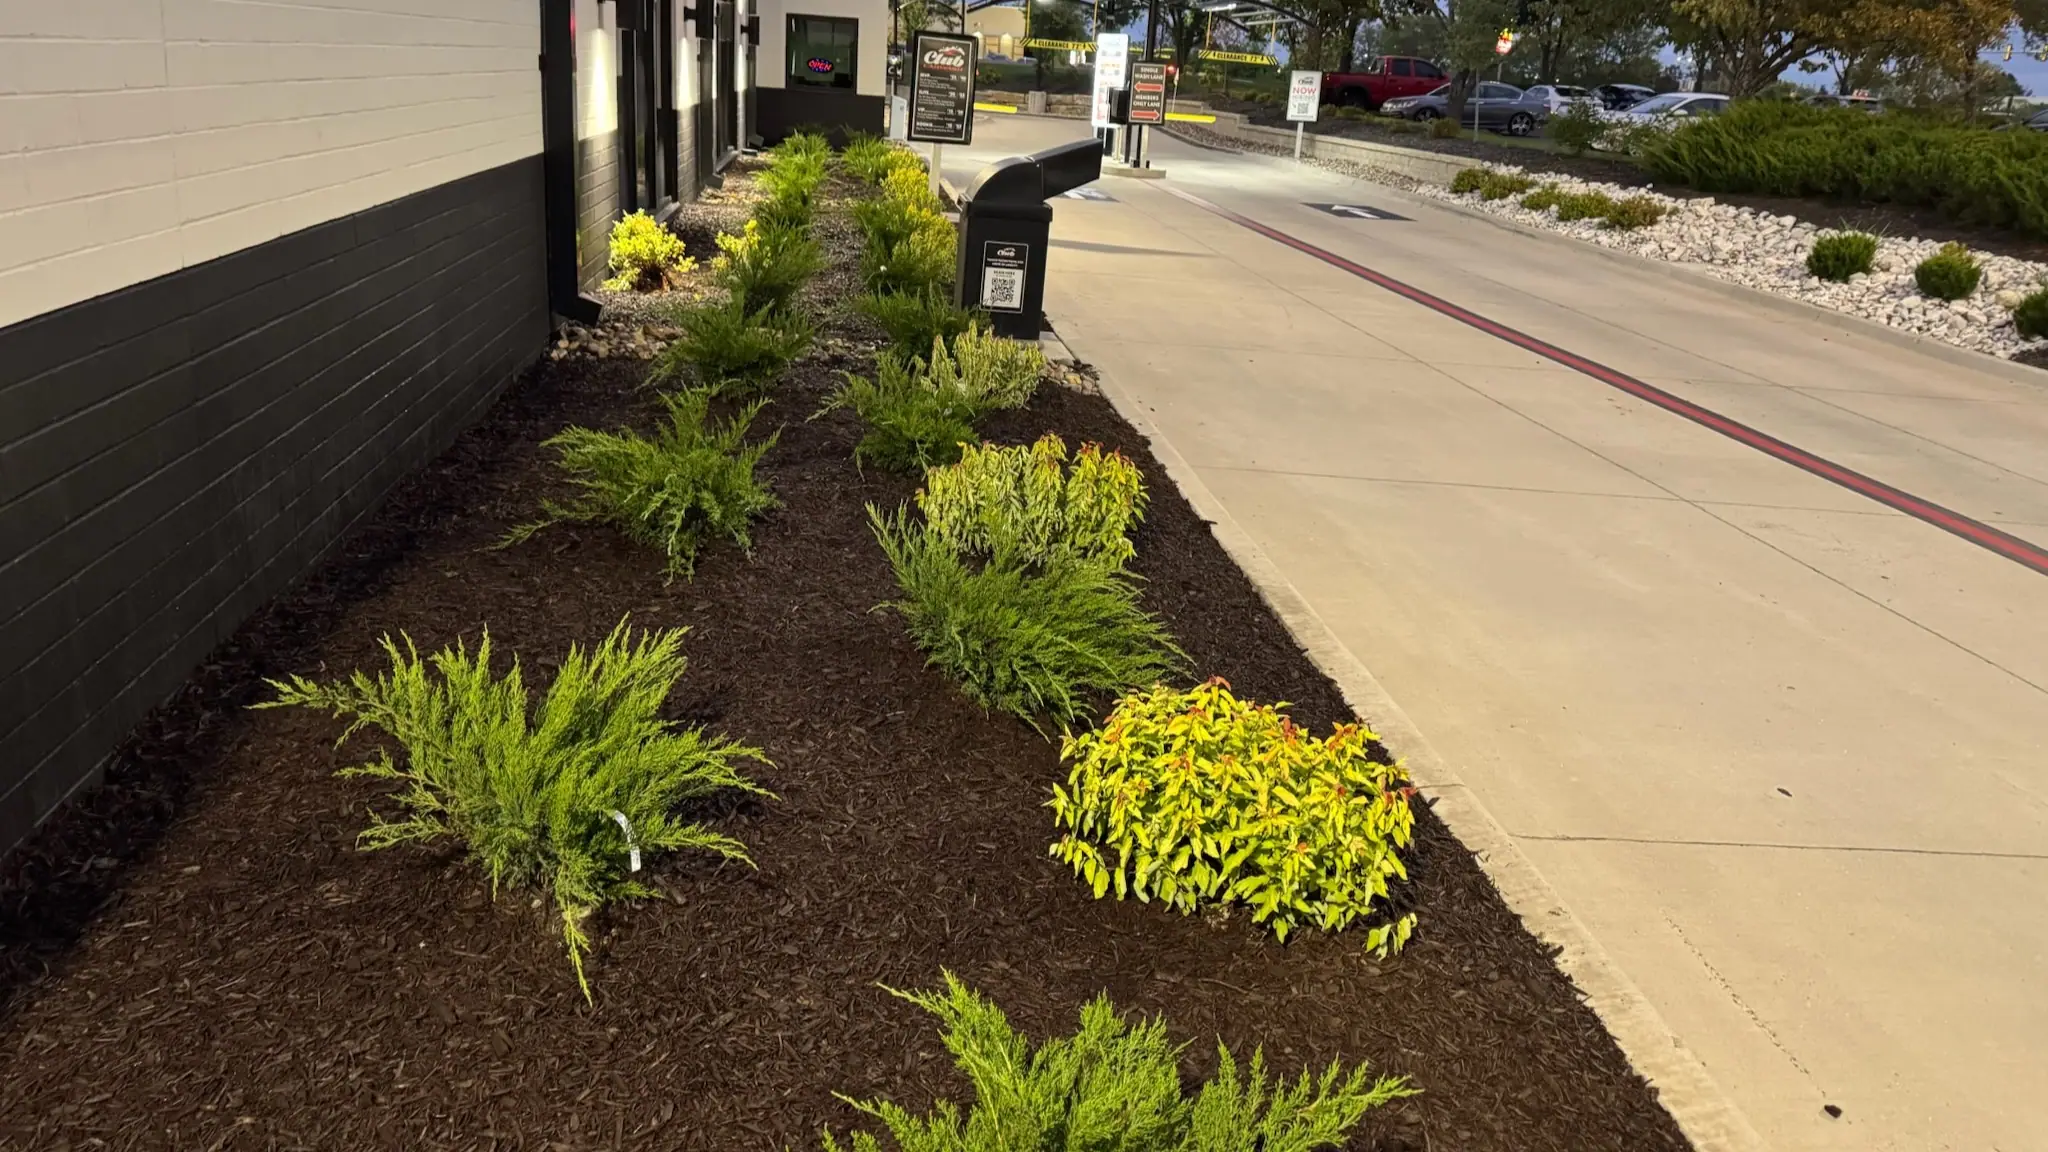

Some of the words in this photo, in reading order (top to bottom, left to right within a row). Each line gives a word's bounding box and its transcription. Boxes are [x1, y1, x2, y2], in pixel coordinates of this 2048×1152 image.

[1038, 40, 1069, 49] CLEARANCE
[923, 51, 965, 68] Club
[1216, 52, 1247, 61] CLEARANCE
[808, 60, 832, 71] OPEN
